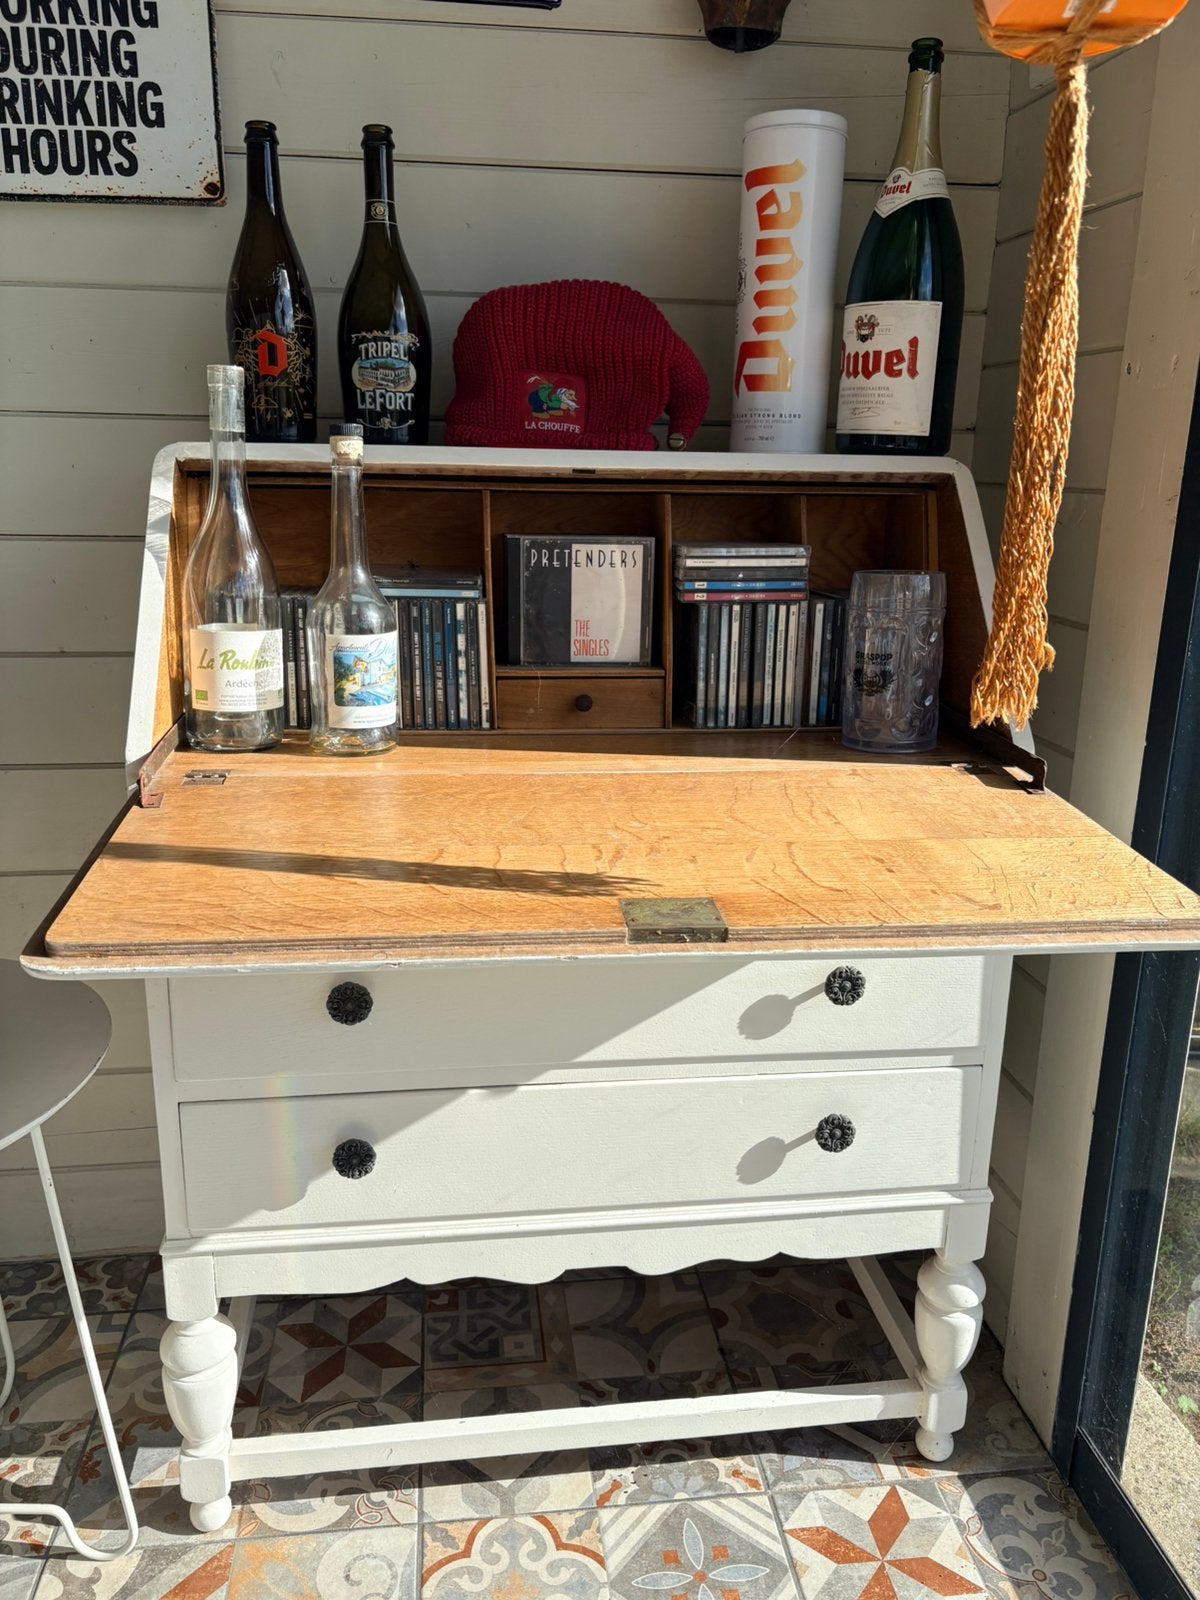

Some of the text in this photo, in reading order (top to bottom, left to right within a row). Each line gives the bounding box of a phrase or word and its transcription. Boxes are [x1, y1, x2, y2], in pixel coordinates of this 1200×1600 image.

[1, 128, 139, 177] HOURS
[255, 329, 289, 377] D
[358, 342, 409, 360] TRIPEL
[525, 421, 581, 434] LA CHOUFFE
[530, 549, 637, 568] PRETENDERS
[574, 620, 591, 637] THE
[573, 639, 610, 657] SINGLES
[197, 648, 215, 670] La
